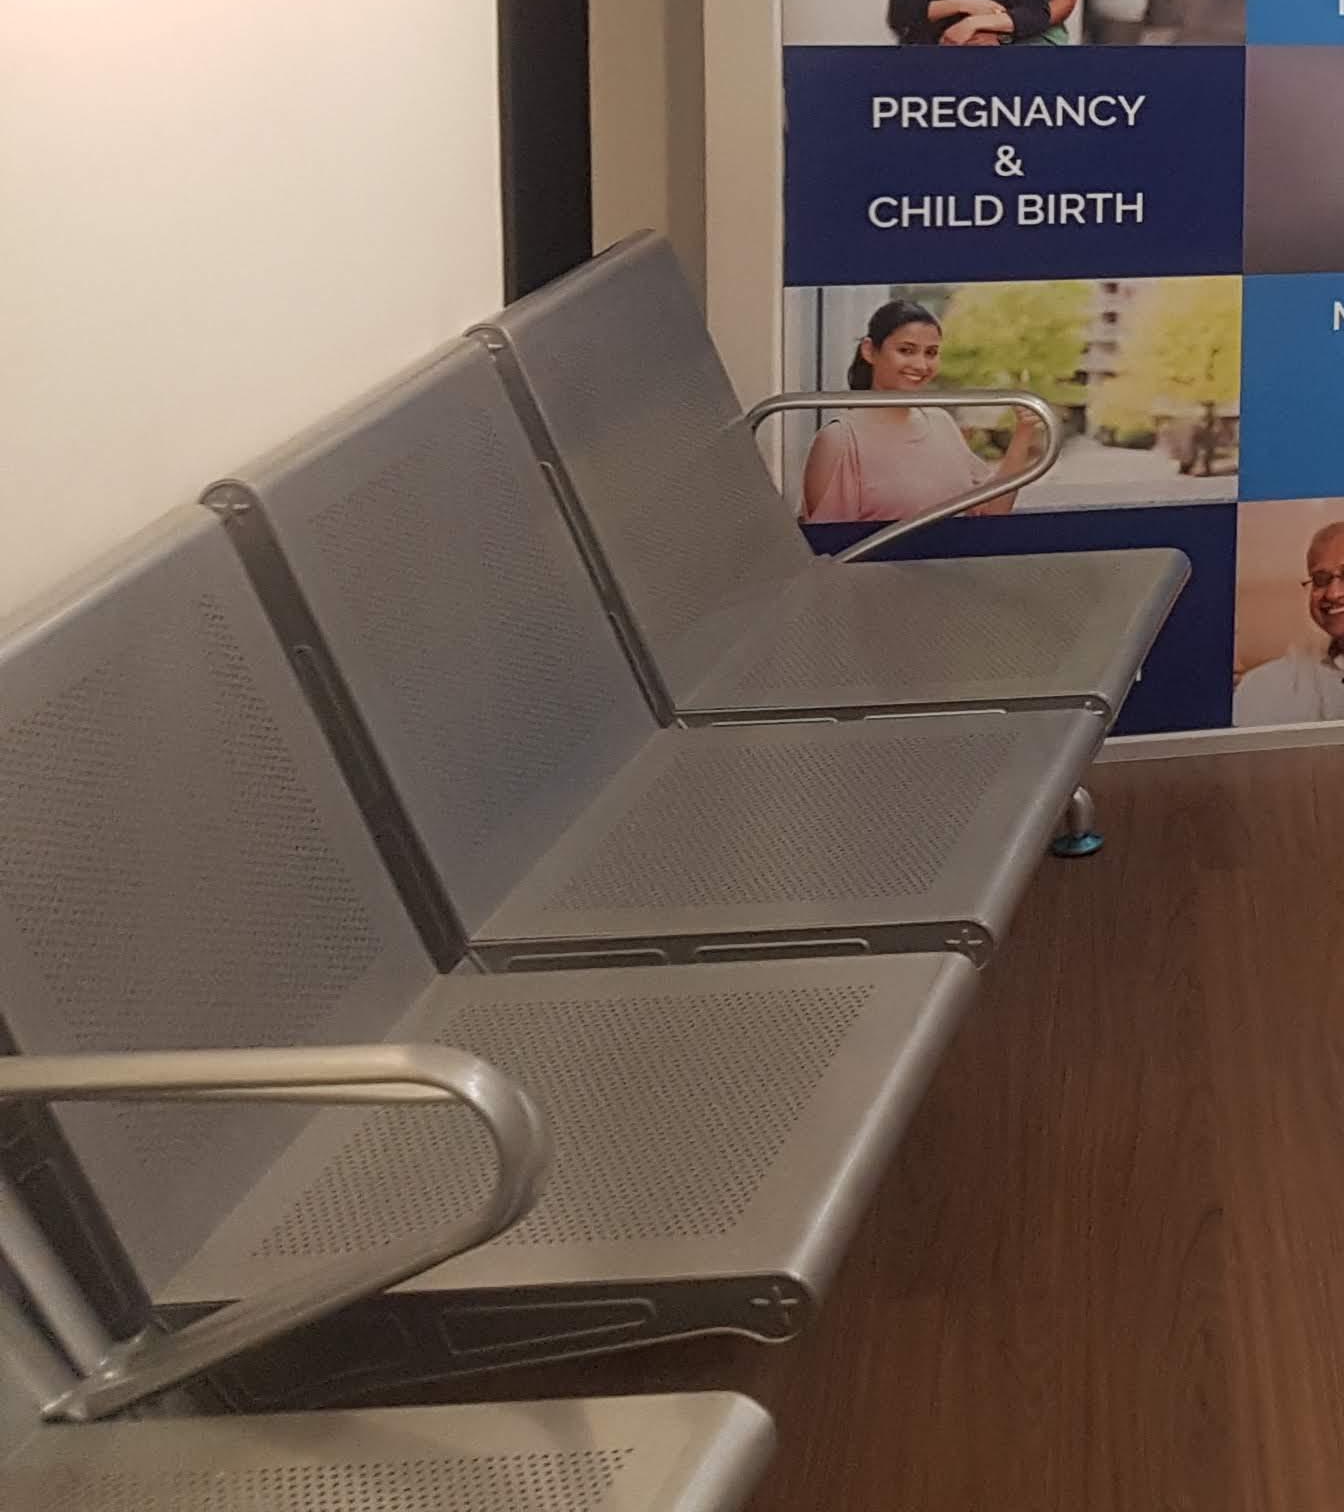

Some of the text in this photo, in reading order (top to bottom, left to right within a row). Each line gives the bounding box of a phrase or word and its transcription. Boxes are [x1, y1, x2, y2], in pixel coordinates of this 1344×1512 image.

[871, 94, 1146, 128] PREGNANCY
[993, 144, 1024, 178] &
[867, 192, 1145, 229] CHILD BIRTH
